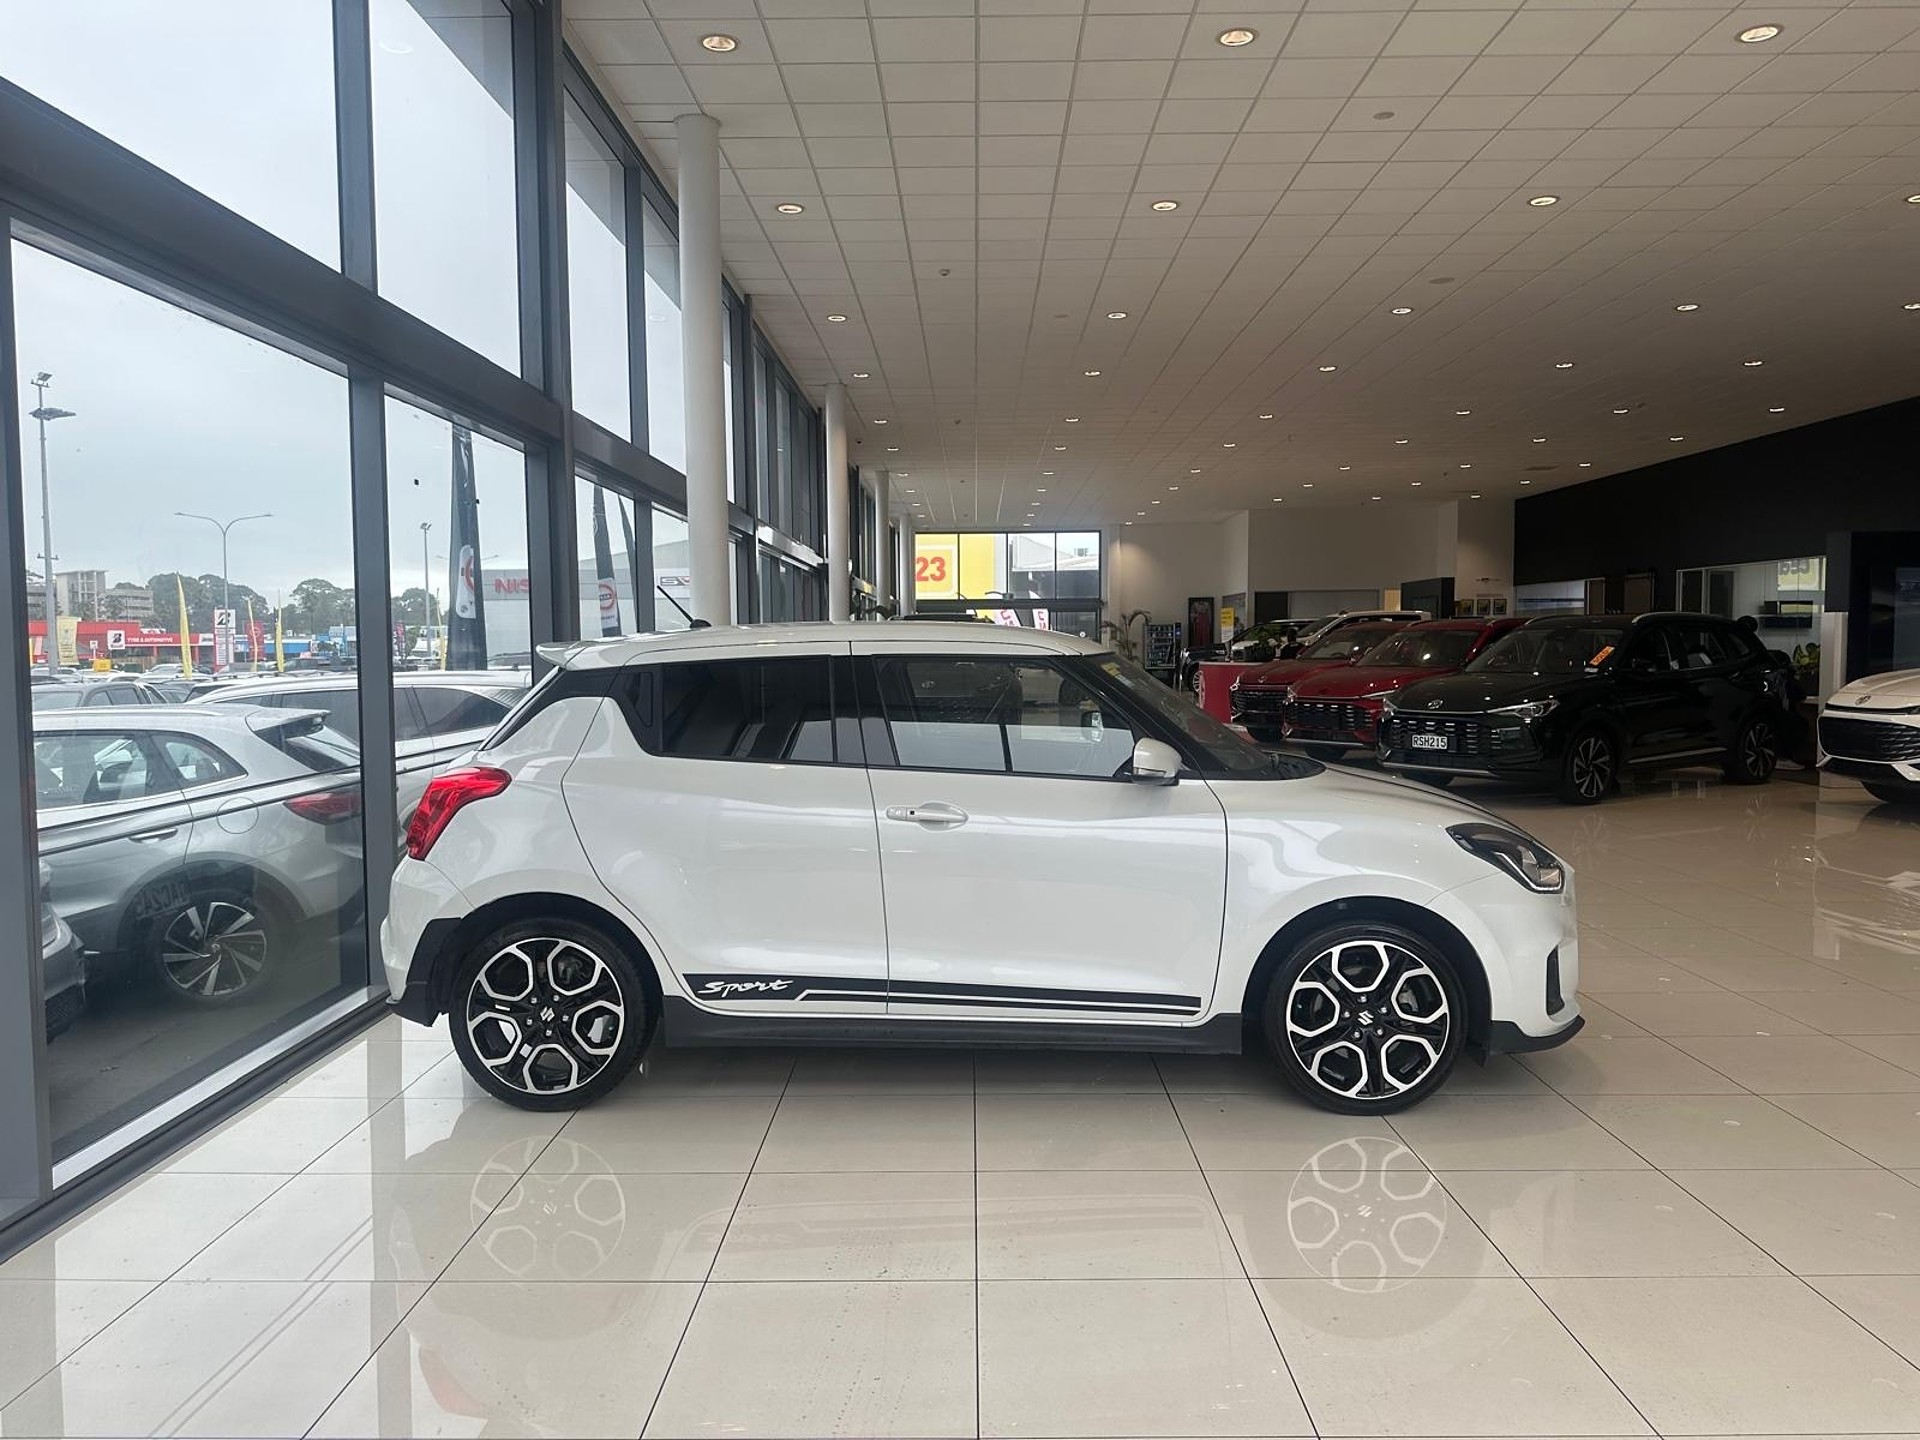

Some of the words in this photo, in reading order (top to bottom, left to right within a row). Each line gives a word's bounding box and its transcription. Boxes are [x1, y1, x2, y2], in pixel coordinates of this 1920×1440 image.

[916, 556, 946, 582] 23
[1413, 736, 1447, 748] RSH215
[698, 980, 794, 998] Sport
